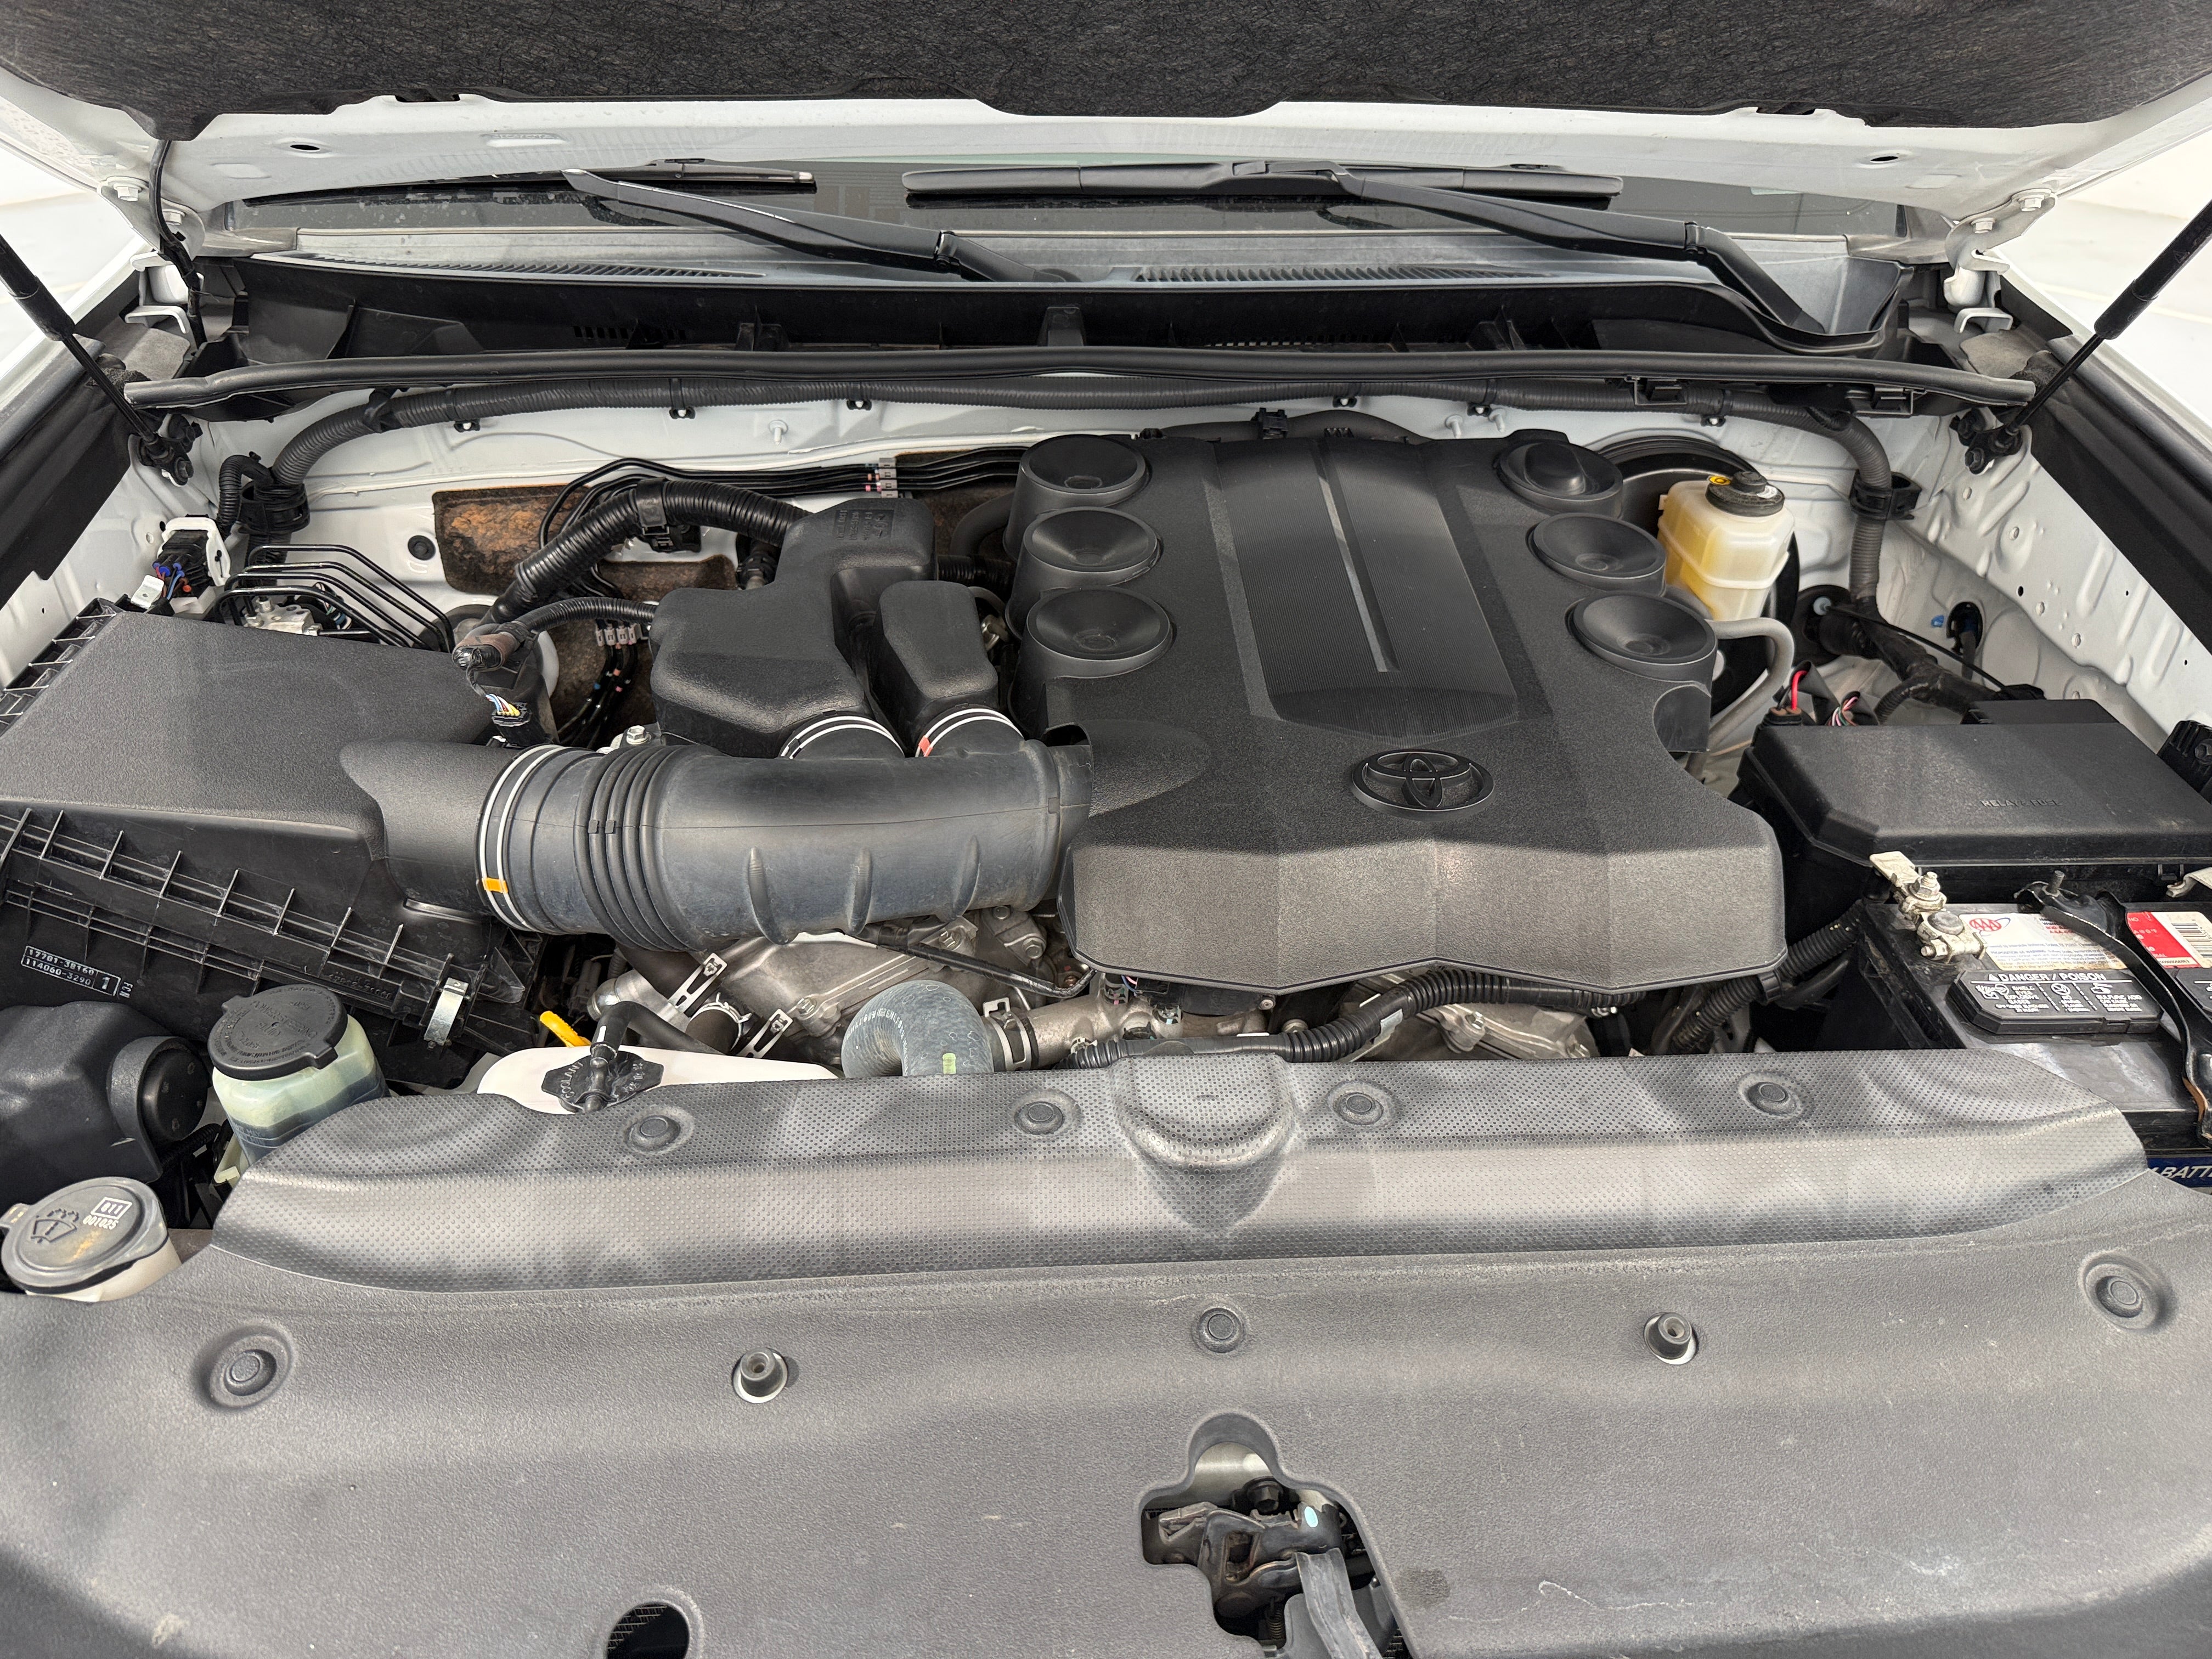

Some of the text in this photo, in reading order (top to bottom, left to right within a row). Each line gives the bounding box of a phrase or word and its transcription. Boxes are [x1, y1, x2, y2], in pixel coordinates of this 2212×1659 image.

[1980, 799, 2019, 808] RELAY
[1972, 919, 2001, 930] AAA
[29, 949, 94, 975] 17701-38160
[26, 958, 91, 986] 114060-3290
[1997, 973, 2051, 981] DANGER
[2058, 973, 2107, 981] POISON
[101, 977, 110, 990] 1
[119, 981, 133, 998] FCN
[560, 1062, 584, 1099] COOLANT
[2159, 1165, 2212, 1179] BATT
[82, 1215, 119, 1230] 001025
